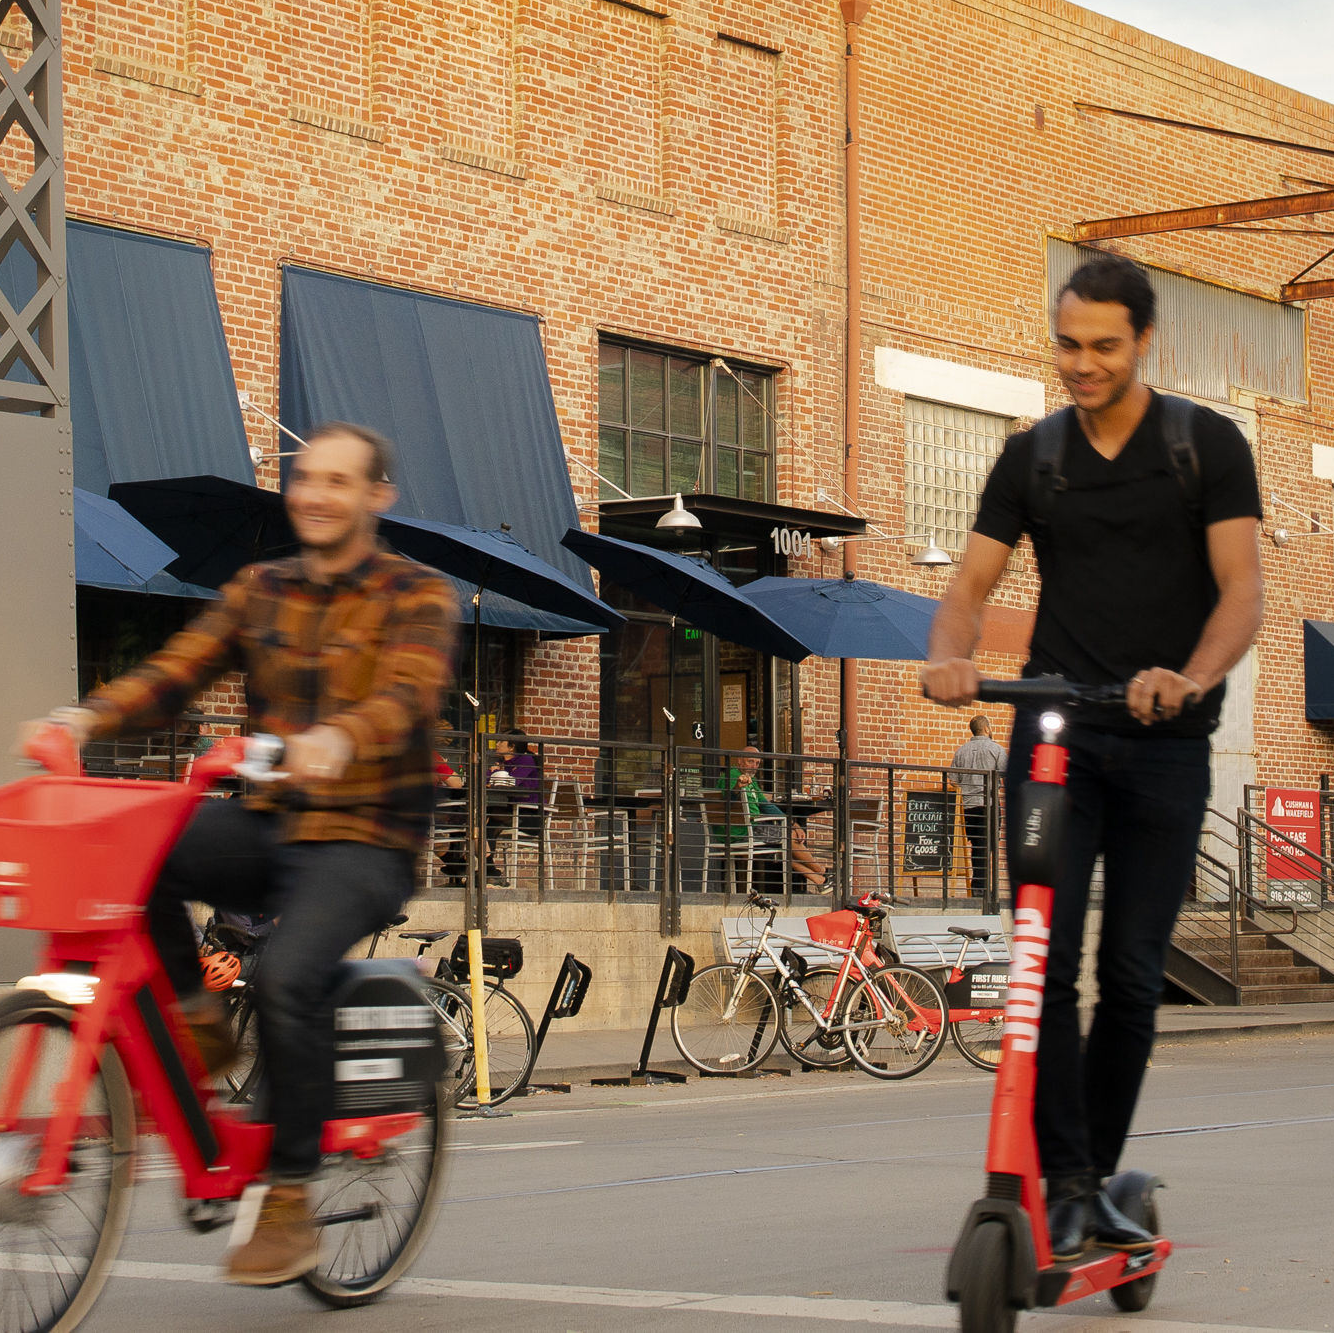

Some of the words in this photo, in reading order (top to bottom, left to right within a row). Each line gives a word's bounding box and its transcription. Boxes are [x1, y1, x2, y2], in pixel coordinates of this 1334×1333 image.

[770, 527, 812, 559] 1001
[1285, 800, 1309, 809] CUSHMAN
[1310, 801, 1313, 809] &
[1285, 810, 1314, 818] WAKEFIELD
[912, 823, 939, 832] MUSIC
[914, 846, 938, 855] GOOSE
[1271, 890, 1283, 901] 916
[972, 974, 991, 983] FIRST
[991, 974, 1007, 983] RIDE
[1007, 907, 1051, 1052] JUMP
